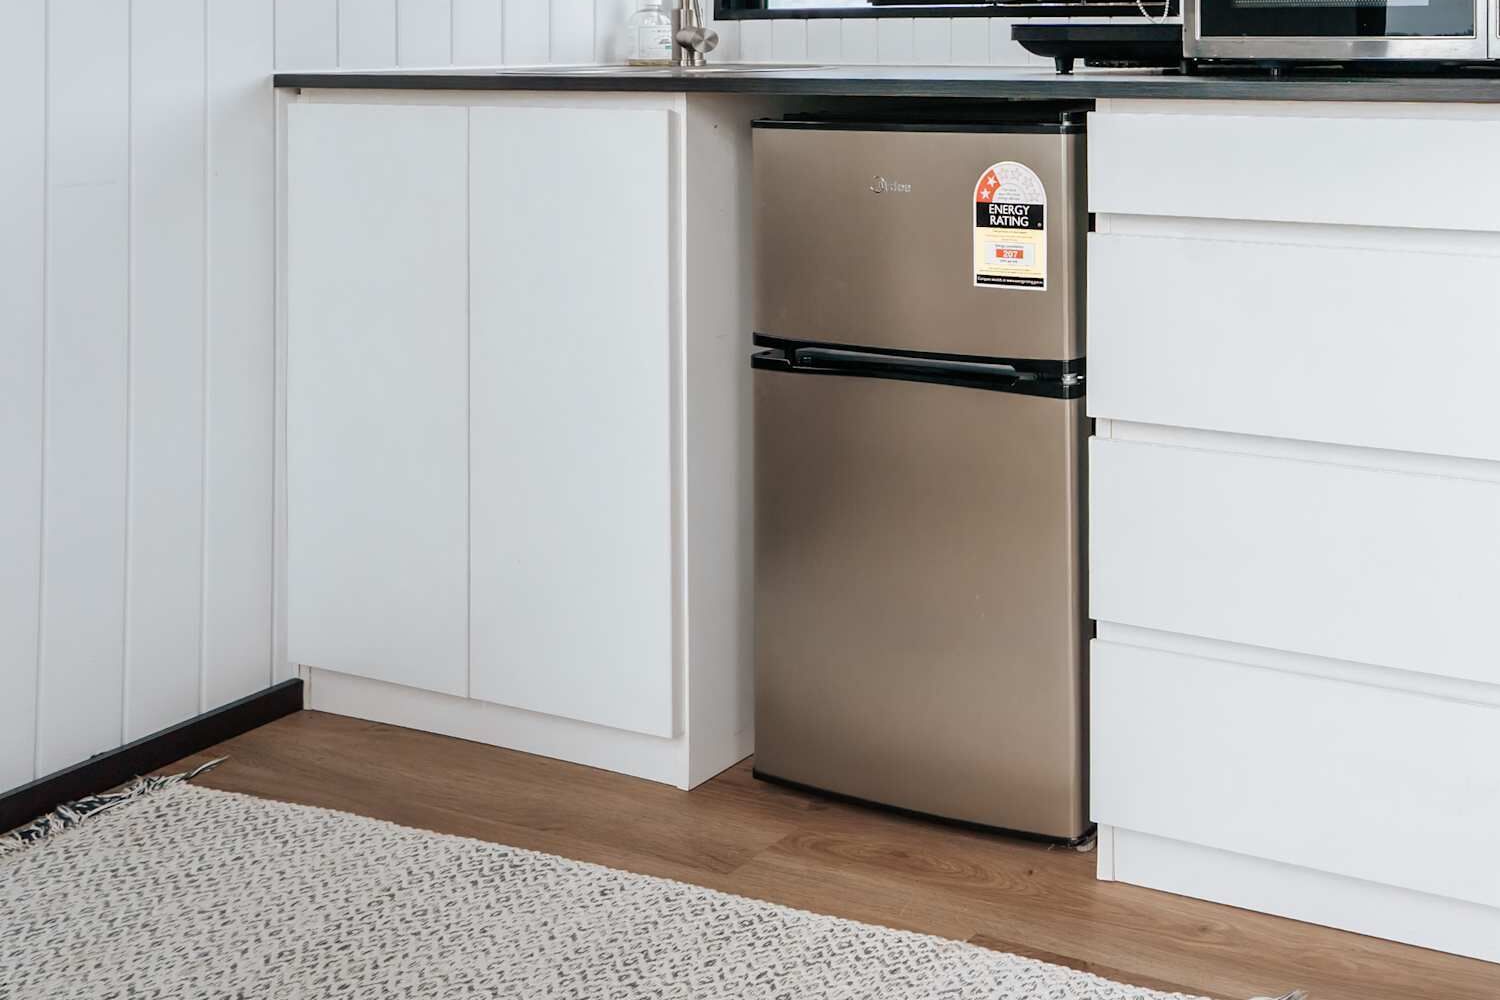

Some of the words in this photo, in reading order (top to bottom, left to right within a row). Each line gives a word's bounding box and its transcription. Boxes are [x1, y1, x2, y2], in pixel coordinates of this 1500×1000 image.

[988, 204, 1030, 216] ENERGY
[989, 215, 1029, 227] RATING
[1002, 250, 1018, 258] 207
